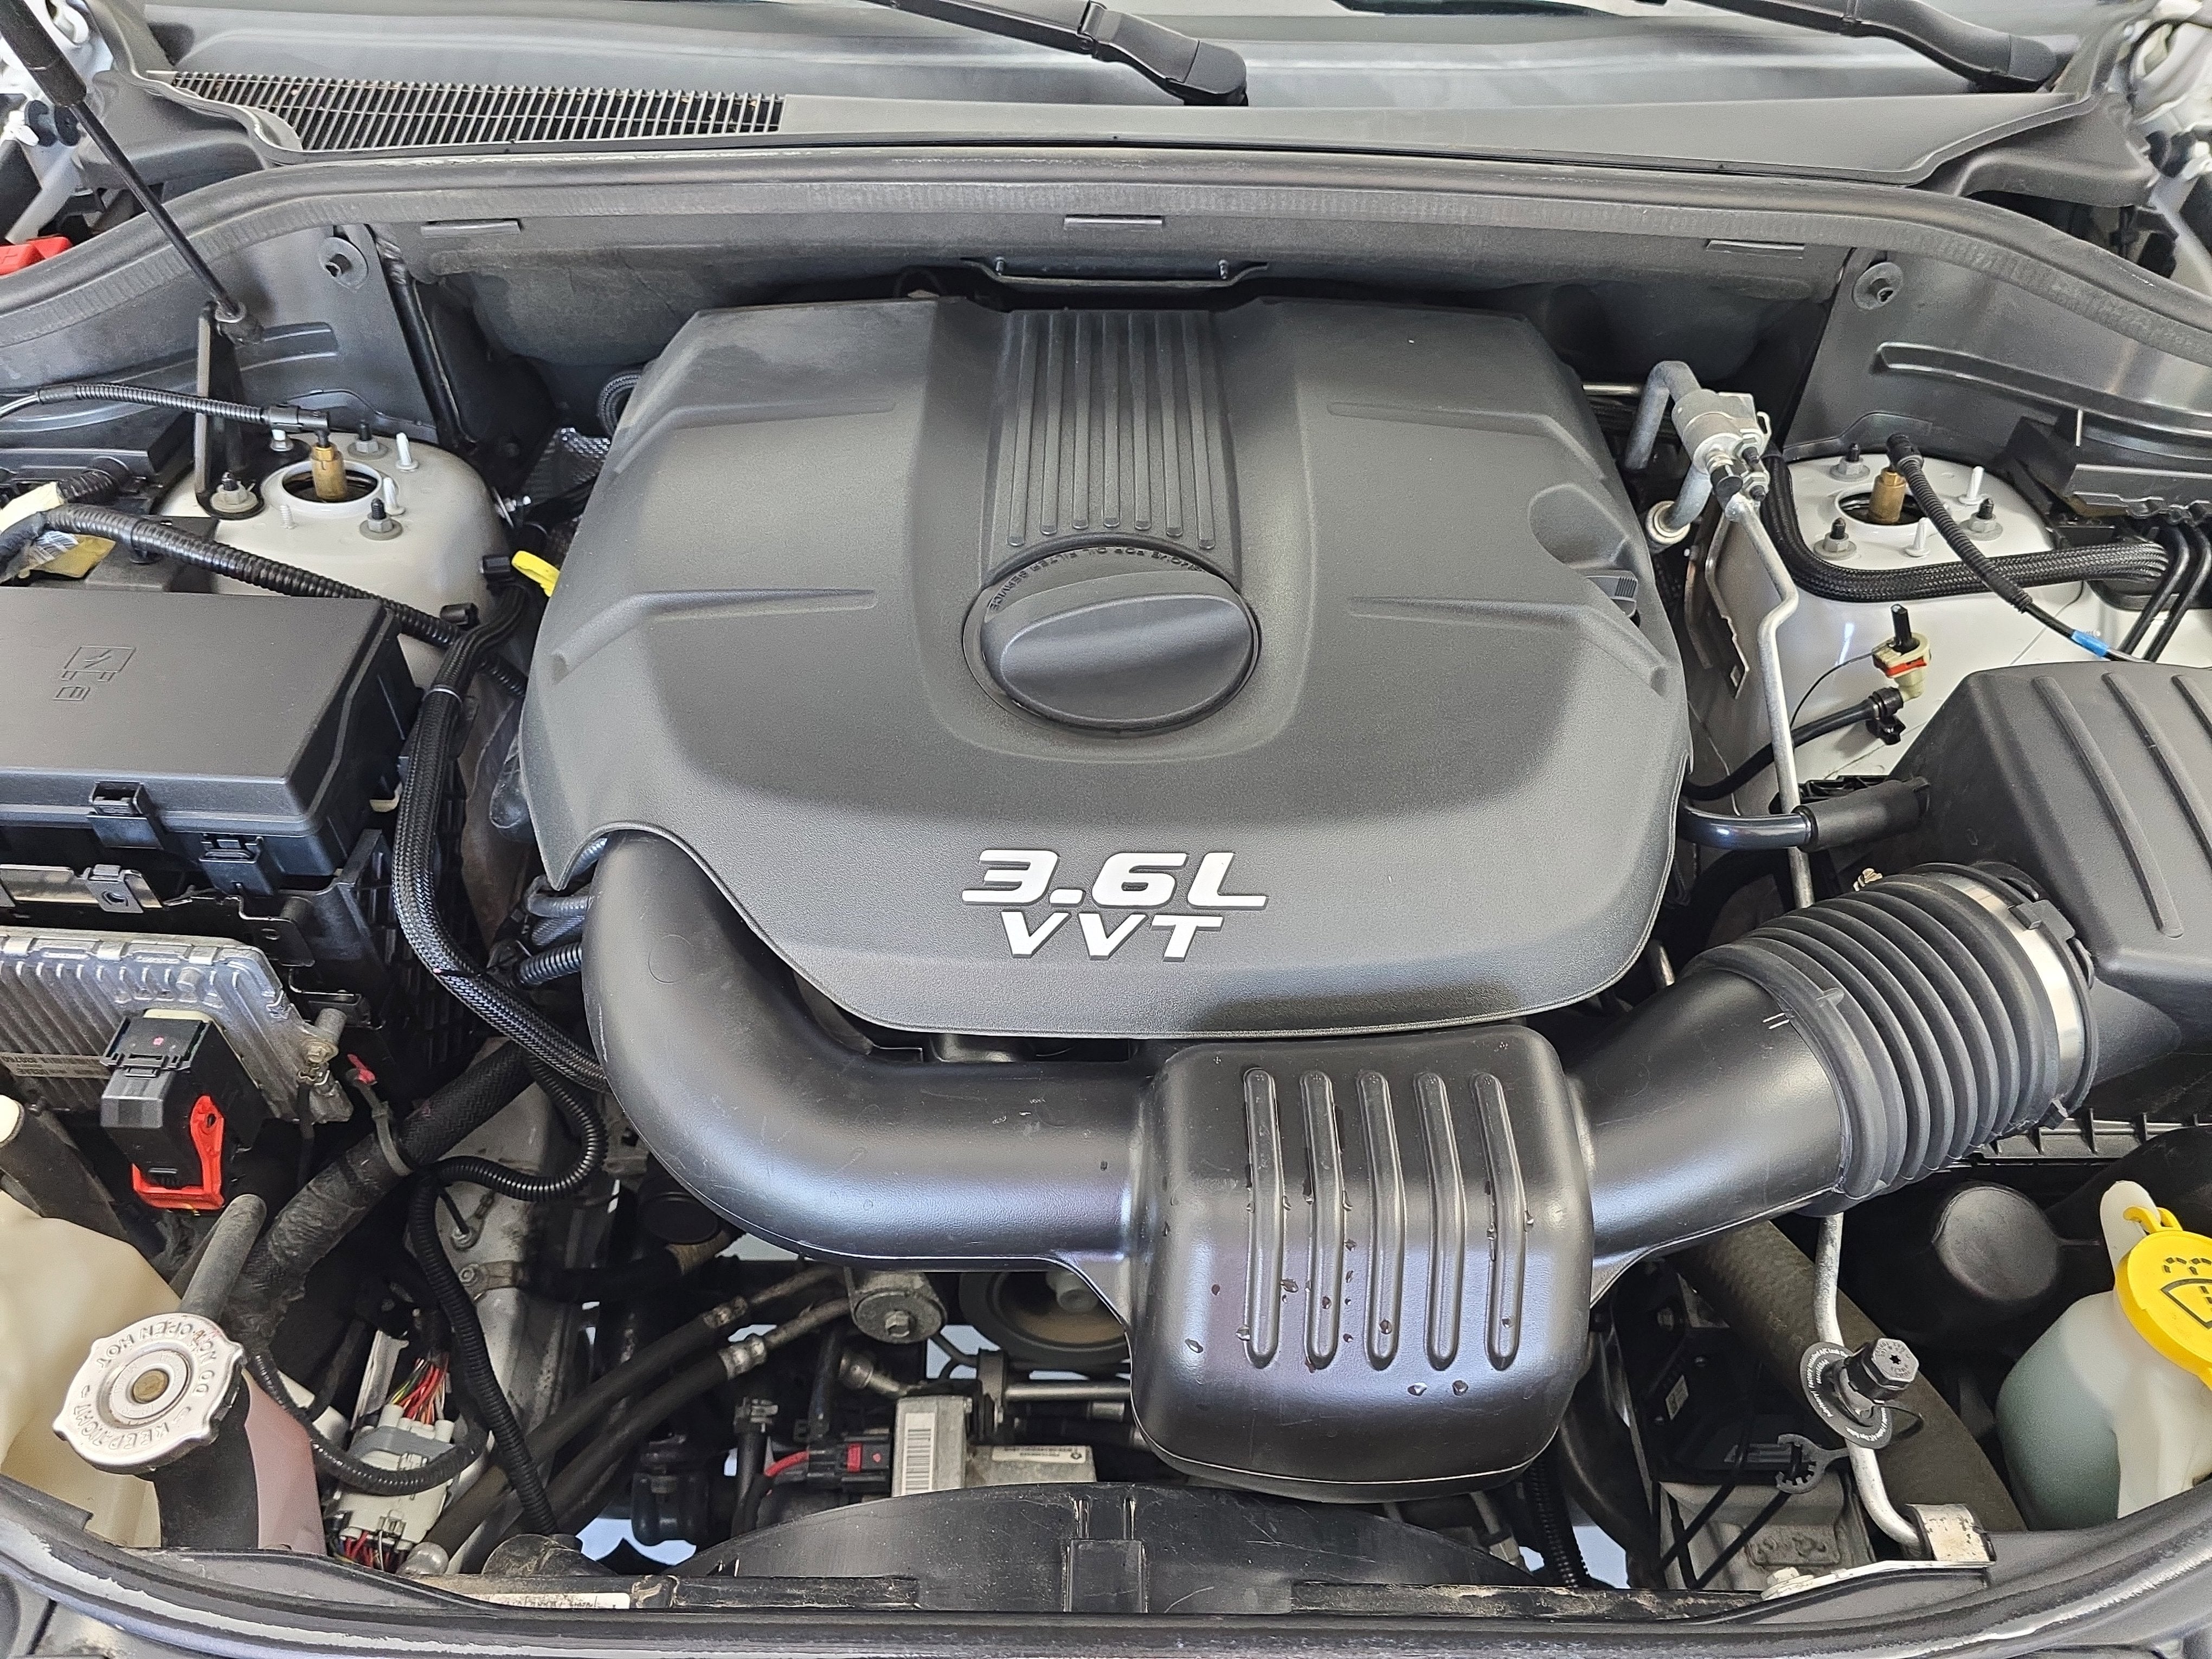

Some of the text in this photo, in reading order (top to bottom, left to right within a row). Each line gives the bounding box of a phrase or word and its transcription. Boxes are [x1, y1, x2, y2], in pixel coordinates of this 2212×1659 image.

[1030, 552, 1078, 573] FILTER
[988, 570, 1028, 612] SERVICE
[962, 850, 1269, 909] 3.6L
[1001, 911, 1224, 961] VVT
[139, 1322, 194, 1340] OPEN
[96, 1333, 134, 1369] HOT
[191, 1369, 215, 1398] DO
[108, 1422, 169, 1450] KEEP
